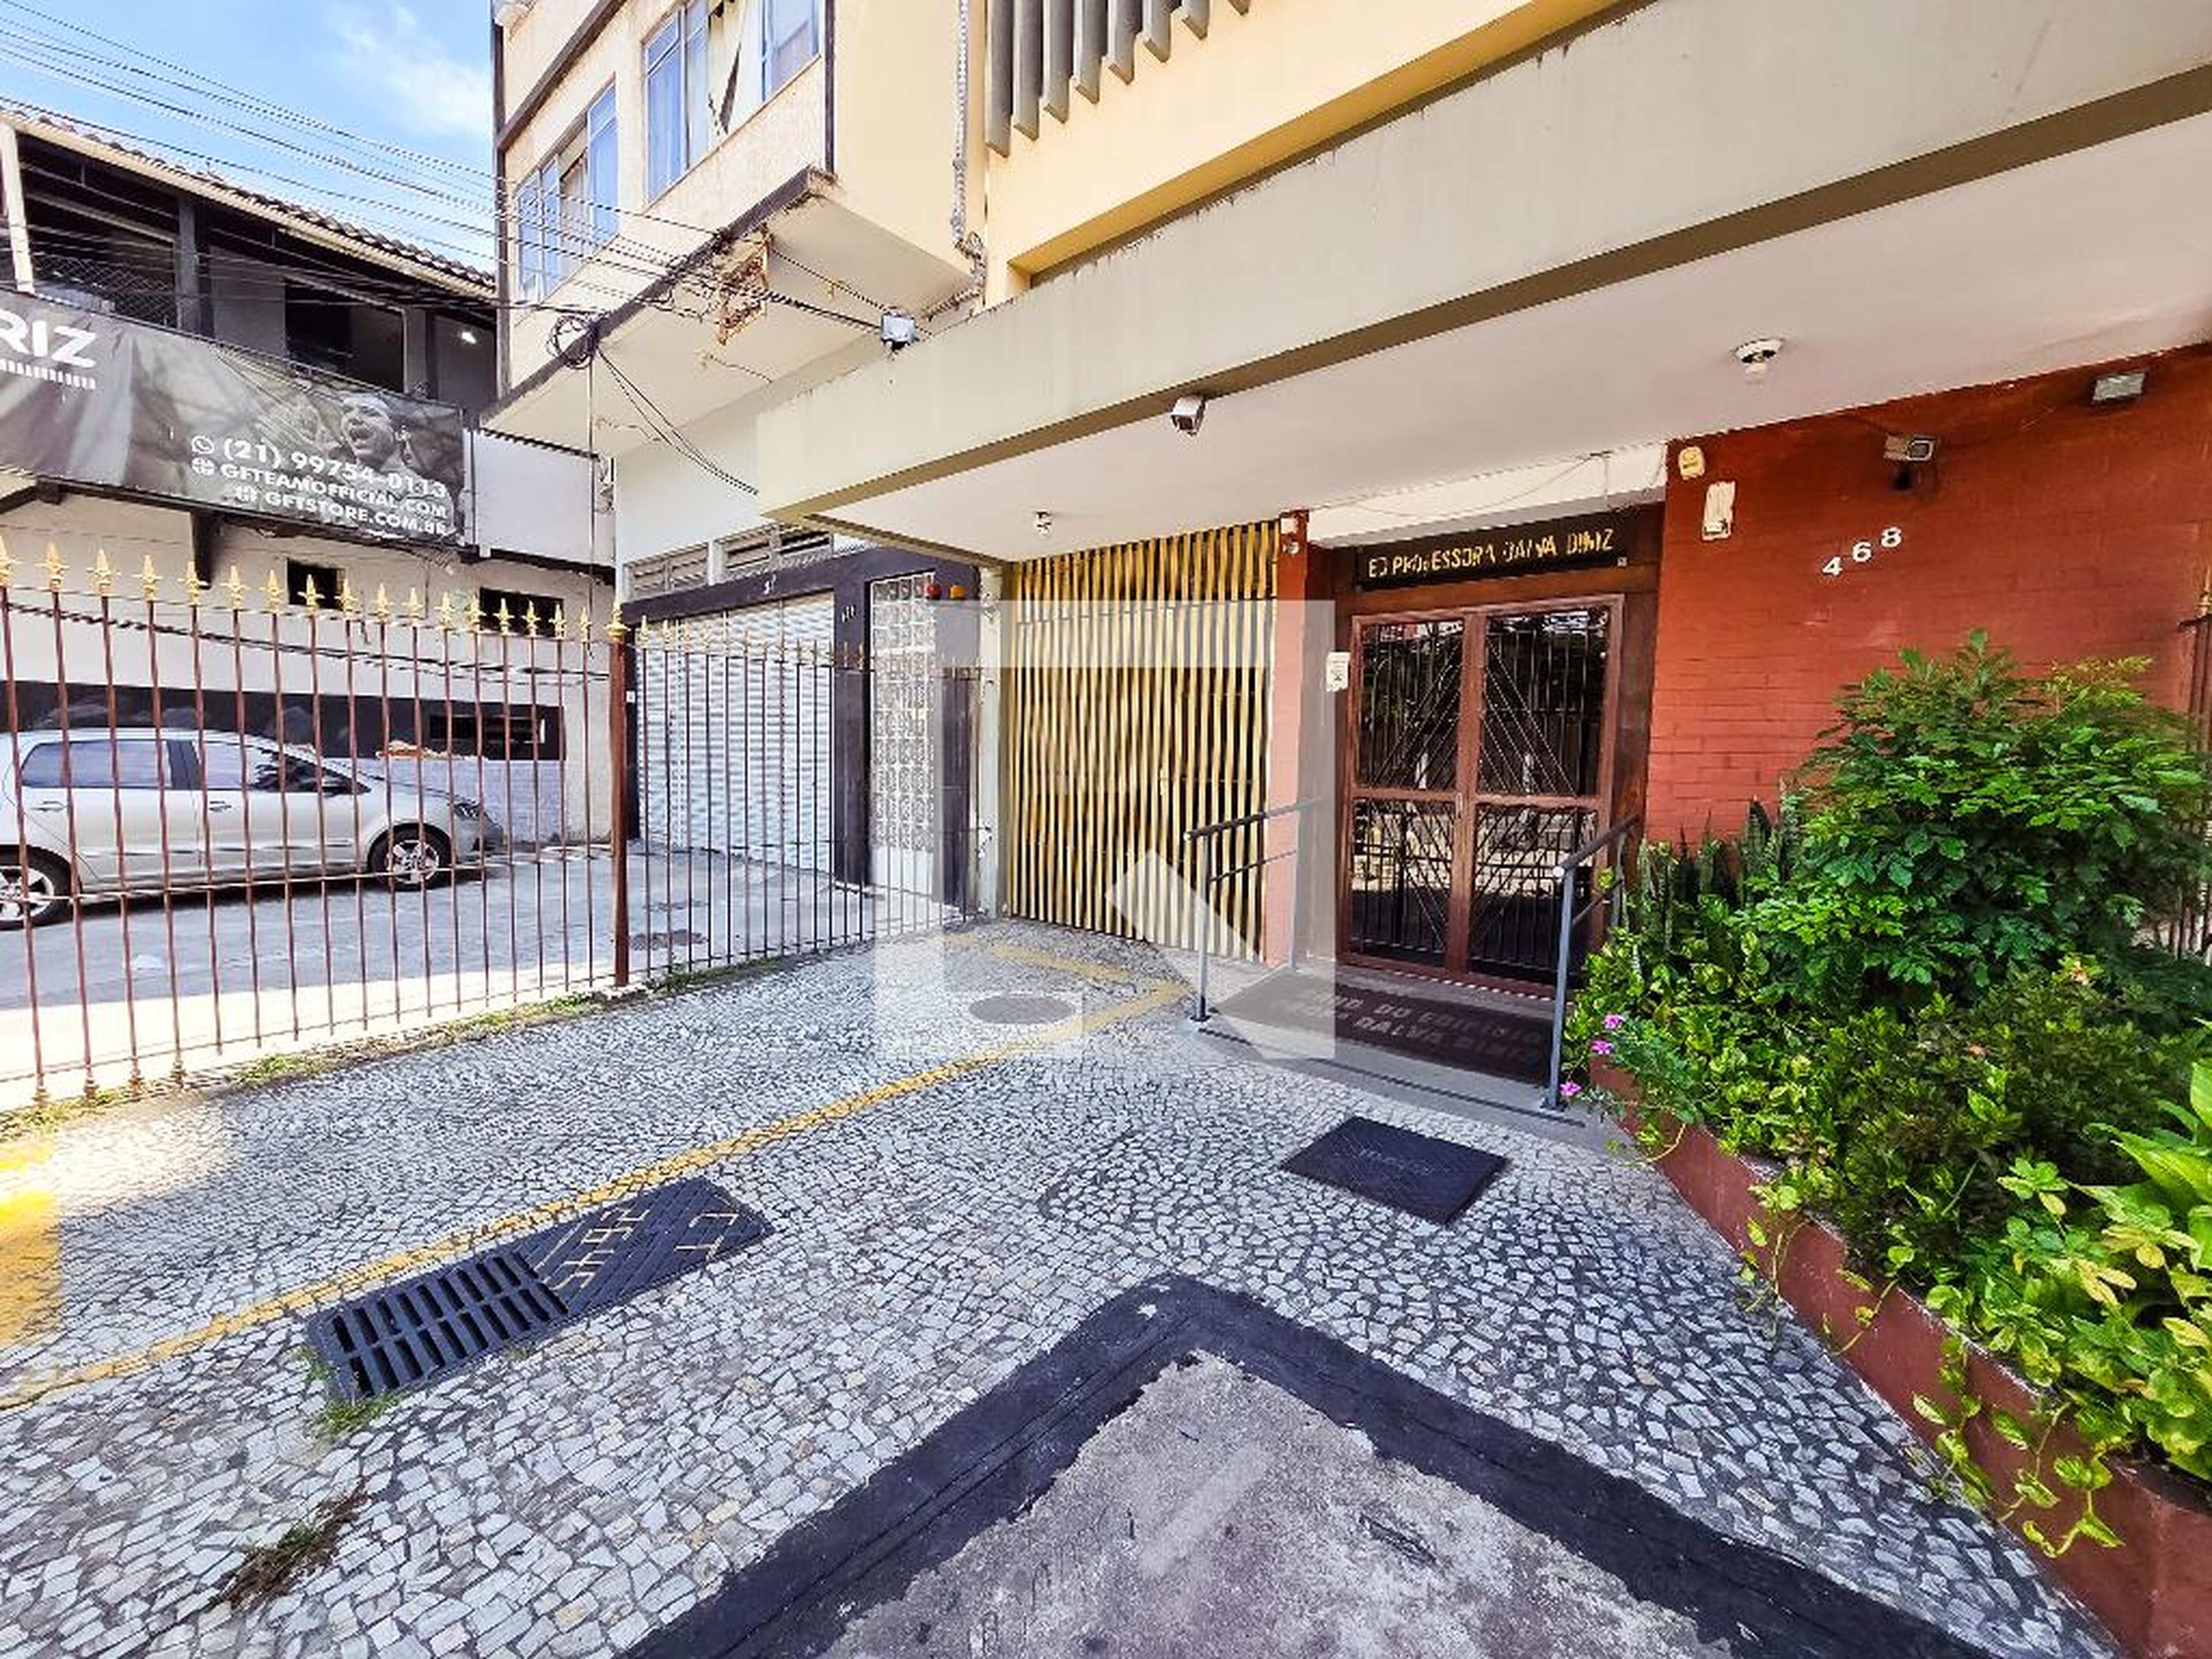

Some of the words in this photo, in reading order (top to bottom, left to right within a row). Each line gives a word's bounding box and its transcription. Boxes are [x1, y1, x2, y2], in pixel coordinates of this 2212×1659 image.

[224, 438, 281, 468] (21)
[220, 463, 446, 520] GFTEAMOFFICIAL.COM
[265, 491, 448, 536] GFTSTORE.COM.BR
[1822, 527, 1902, 576] 468
